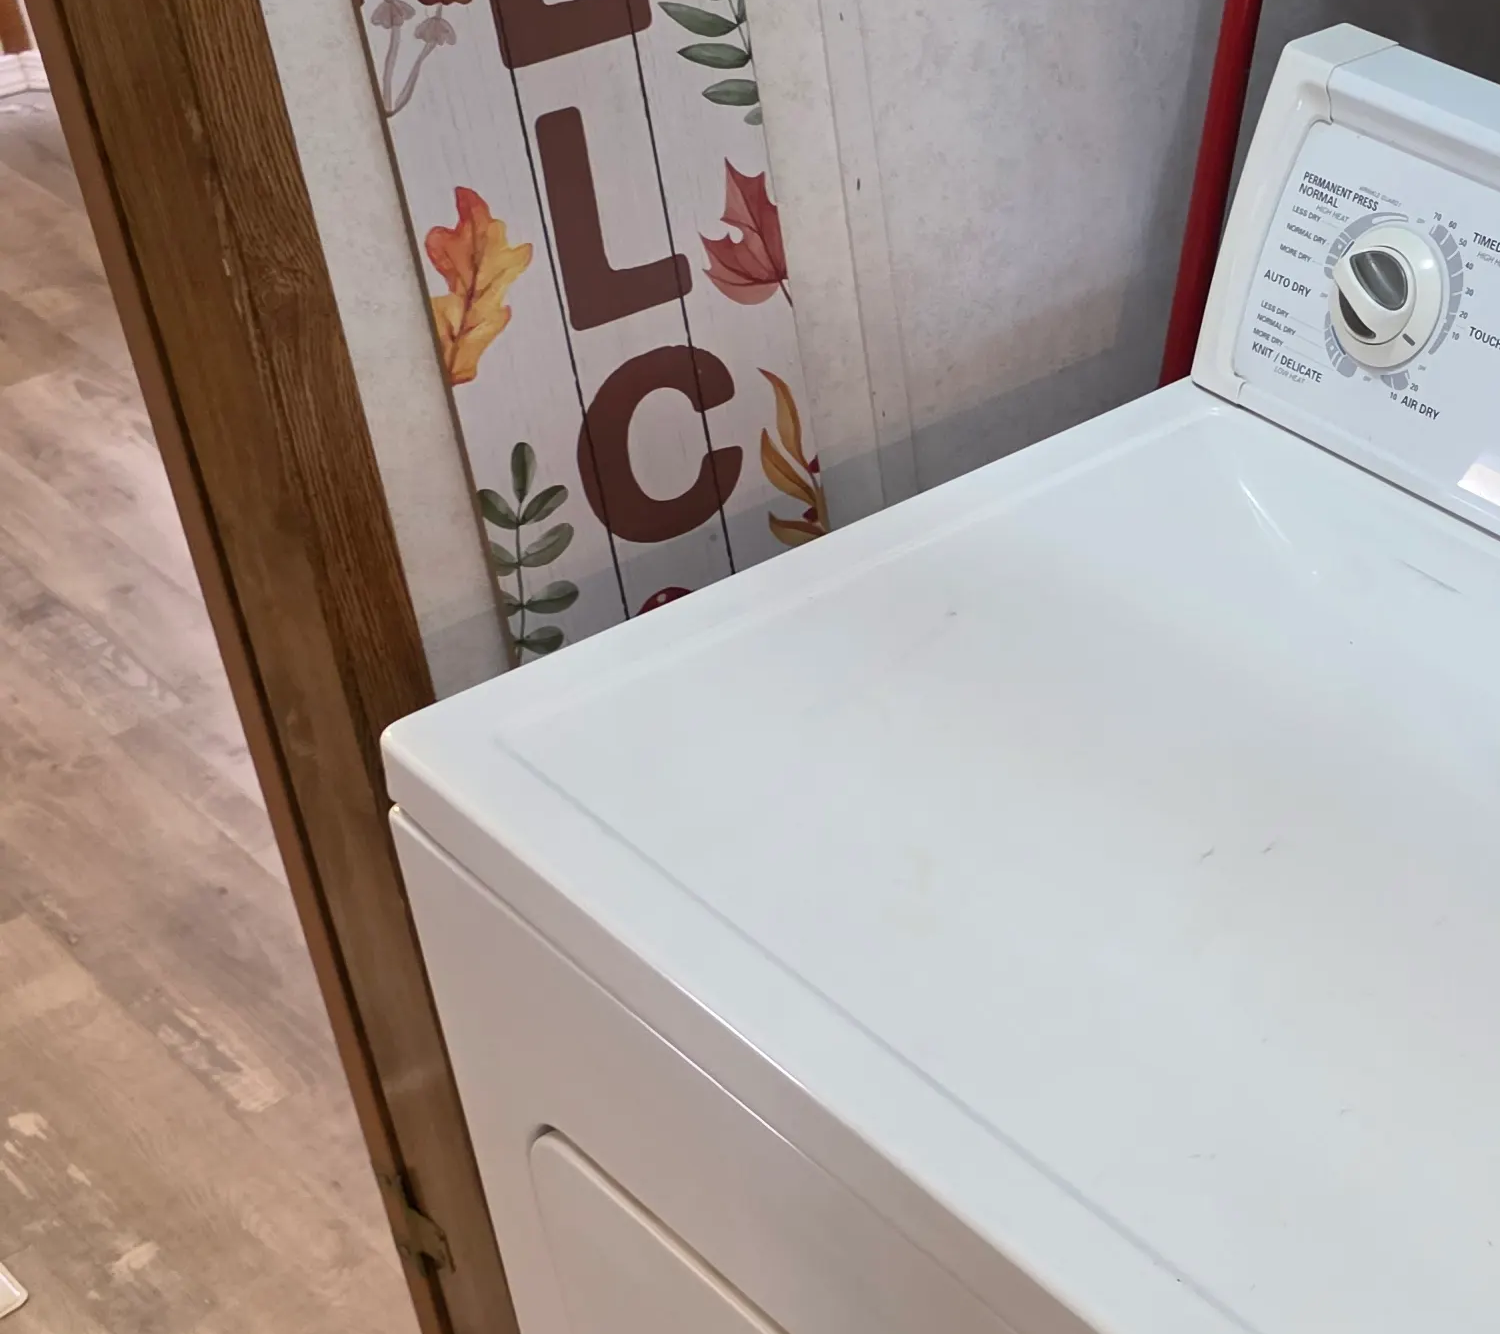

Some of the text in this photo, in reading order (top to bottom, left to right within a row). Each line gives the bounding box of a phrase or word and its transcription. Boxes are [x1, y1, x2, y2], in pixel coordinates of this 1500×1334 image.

[1298, 183, 1339, 208] NORMAL
[1303, 171, 1353, 200] PERMANENT
[1352, 192, 1379, 212] PRESS
[1292, 205, 1322, 223] LESS DRY
[1433, 212, 1442, 221] 70
[1286, 222, 1327, 245] NORMAL DRY
[1279, 243, 1313, 263] MORE DRY
[1465, 261, 1475, 270] 40
[1263, 269, 1312, 297] AUTO DRY
[1260, 300, 1290, 318] LESS DRY
[1459, 310, 1469, 320] 20
[1256, 313, 1297, 336] NORMAL DRY
[1252, 327, 1285, 347] MORE DRY
[1451, 331, 1460, 341] 10
[1251, 341, 1274, 358] KNIT
[1280, 354, 1323, 383] DELICATE
[1389, 391, 1398, 401] 10
[1409, 382, 1419, 392] 20
[1400, 395, 1441, 421] AIR DRY
